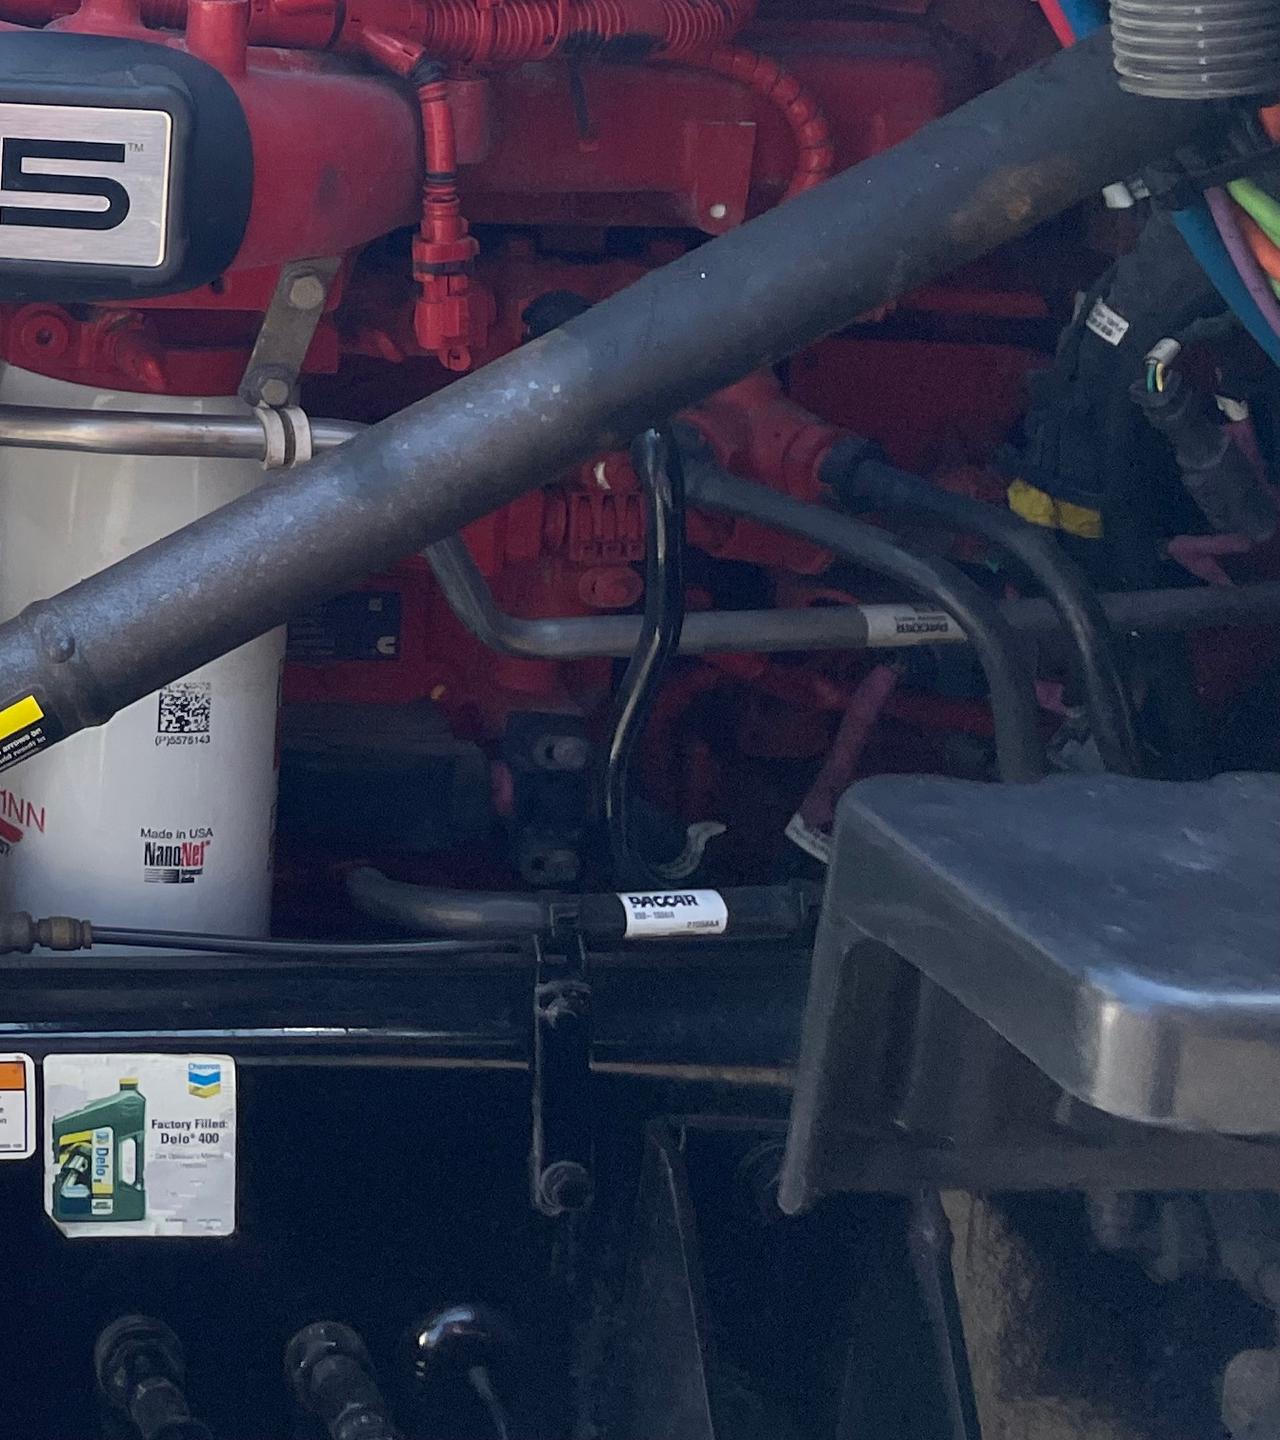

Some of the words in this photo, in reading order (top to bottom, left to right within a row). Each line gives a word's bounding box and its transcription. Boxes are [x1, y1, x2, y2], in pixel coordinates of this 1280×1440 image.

[2, 733, 31, 753] arrows
[140, 828, 173, 839] Made
[176, 829, 187, 839] in
[189, 828, 213, 839] USA
[628, 894, 698, 908] PACCAR
[151, 1119, 191, 1131] Factory
[198, 1132, 219, 1144] 400
[96, 1147, 109, 1176] Delo
